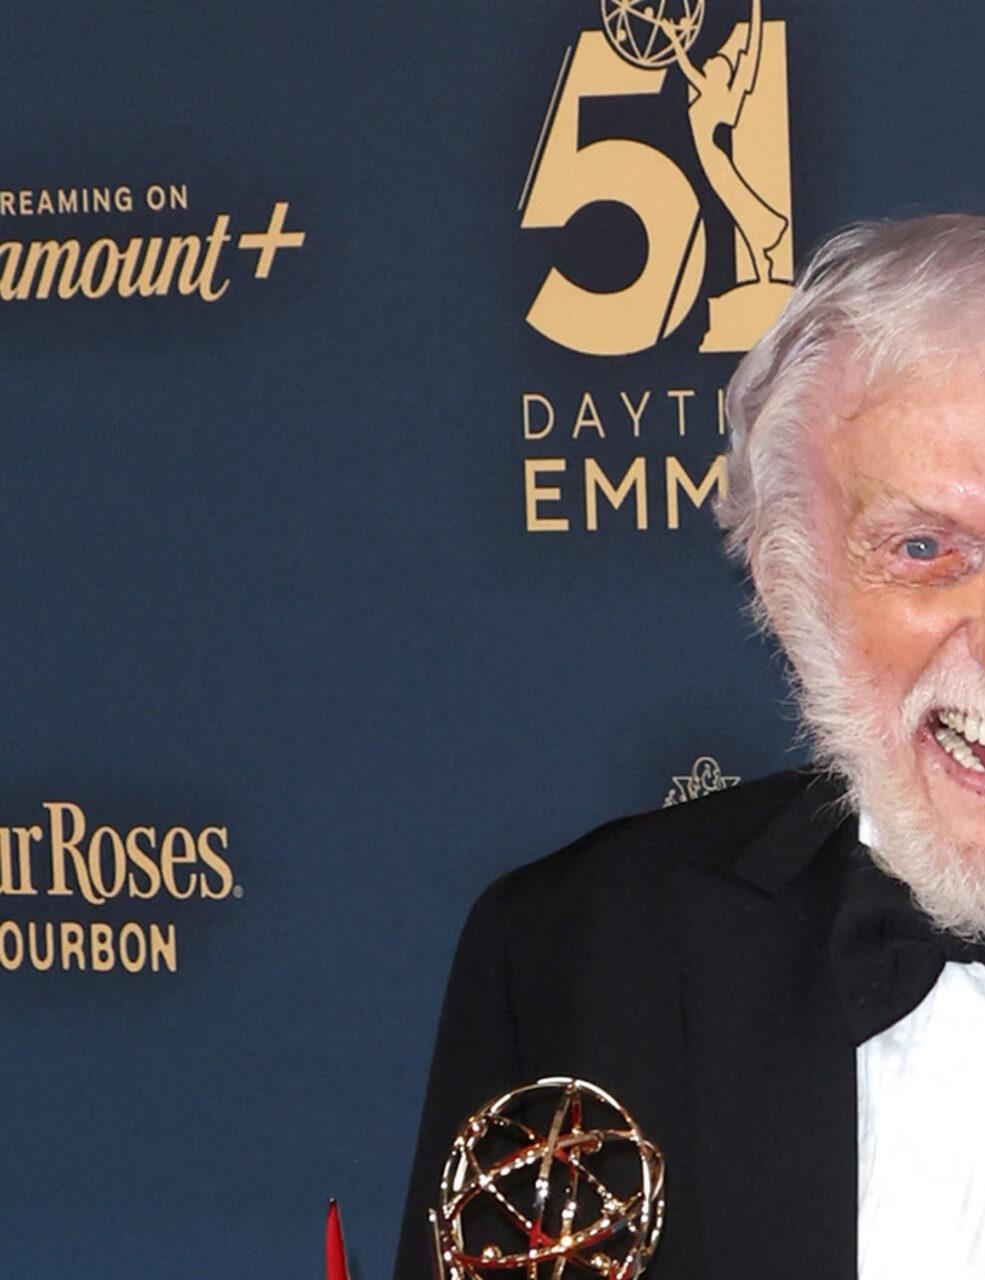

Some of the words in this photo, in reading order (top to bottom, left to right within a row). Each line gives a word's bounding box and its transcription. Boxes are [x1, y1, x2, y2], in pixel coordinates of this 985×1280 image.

[0, 185, 133, 217] REAMING
[146, 184, 188, 211] ON
[523, 388, 725, 440] DAYTI
[524, 456, 730, 532] EMM
[0, 920, 177, 973] OURBON
